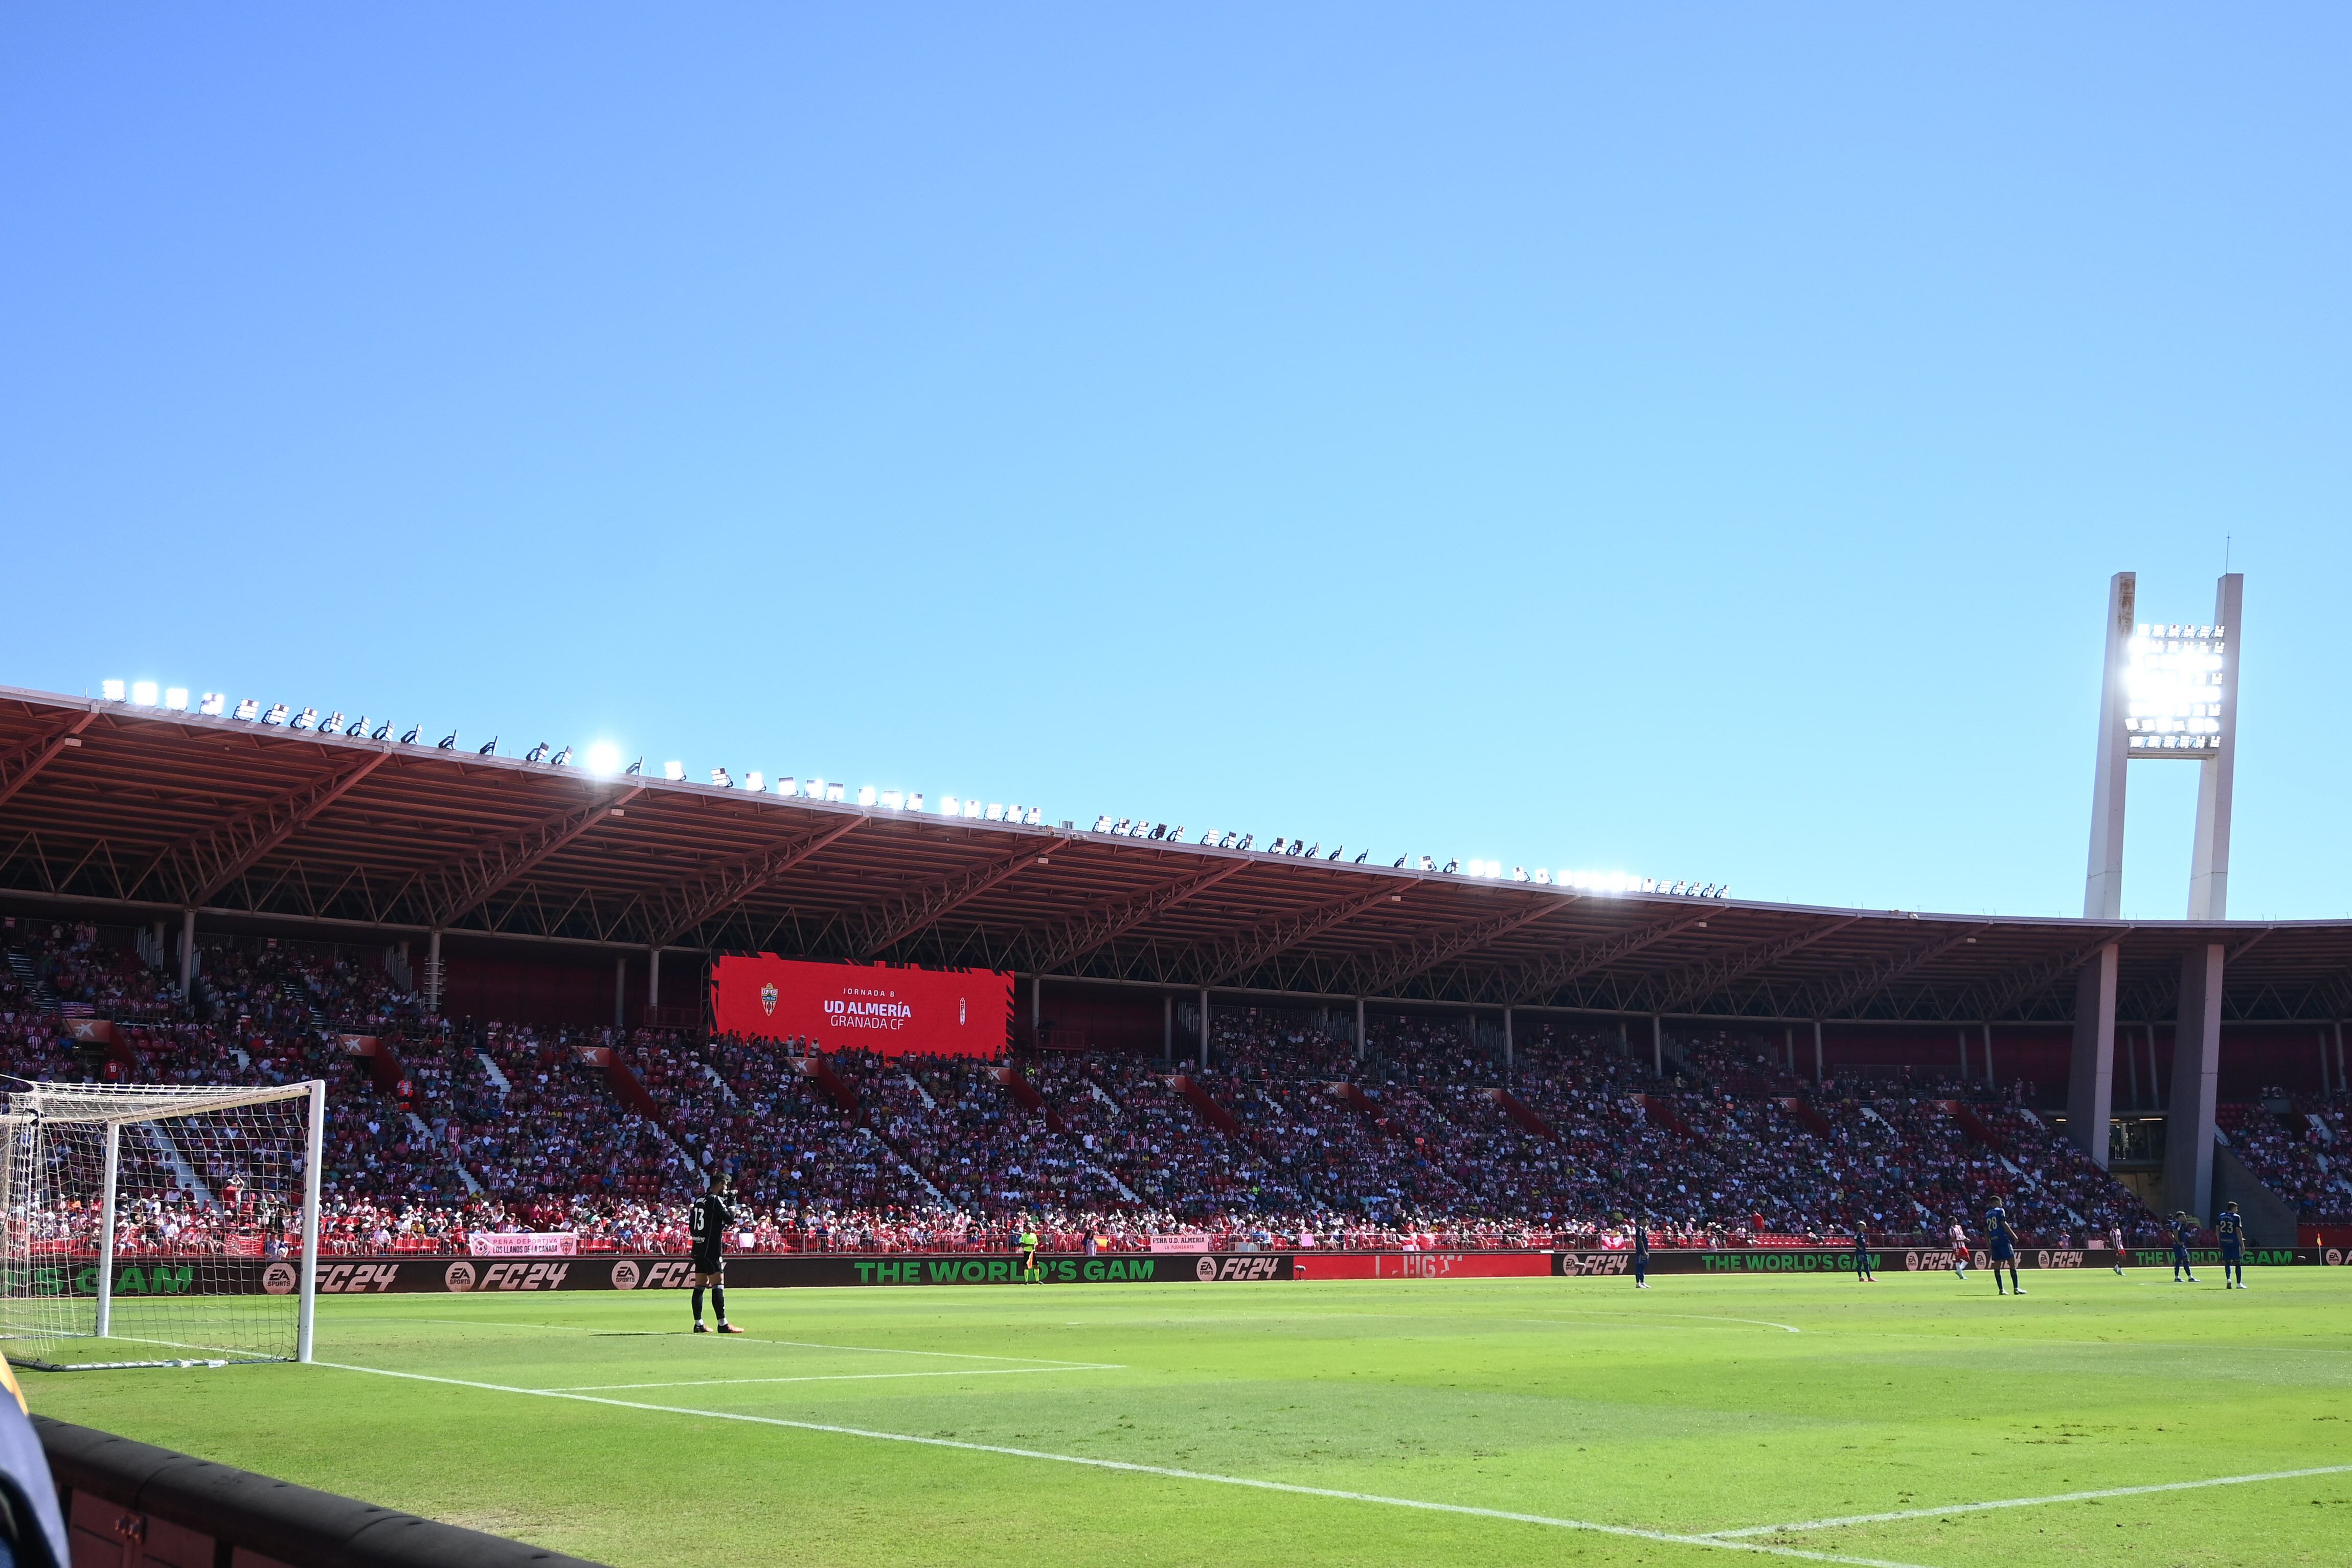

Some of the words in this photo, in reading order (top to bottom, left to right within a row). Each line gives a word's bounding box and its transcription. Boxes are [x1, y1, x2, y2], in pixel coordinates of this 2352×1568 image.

[843, 988, 885, 997] JORNADA
[824, 1000, 844, 1014] UD
[847, 1001, 912, 1018] ALMERÍA
[830, 1015, 888, 1030] GRANADA
[890, 1019, 904, 1030] CF
[693, 1207, 705, 1231] 13
[1986, 1216, 1998, 1232] 28
[2220, 1220, 2233, 1234] 23
[493, 1245, 503, 1254] LOS
[504, 1245, 523, 1254] LLANOS
[538, 1243, 558, 1253] CAÑADA
[1581, 1255, 1629, 1275] FC24
[1702, 1255, 1742, 1271] THE
[1746, 1254, 1834, 1270] WORLD'S
[2051, 1252, 2083, 1268] FC24
[2135, 1252, 2164, 1265] THE
[2241, 1251, 2293, 1264] GAM
[450, 1268, 470, 1279] EA
[616, 1267, 635, 1277] EA
[854, 1262, 921, 1283] THE
[1083, 1260, 1155, 1281] GAM
[1200, 1262, 1213, 1270] EA
[1218, 1258, 1279, 1280] FC24
[269, 1269, 290, 1280] EA
[478, 1263, 570, 1290] FC24
